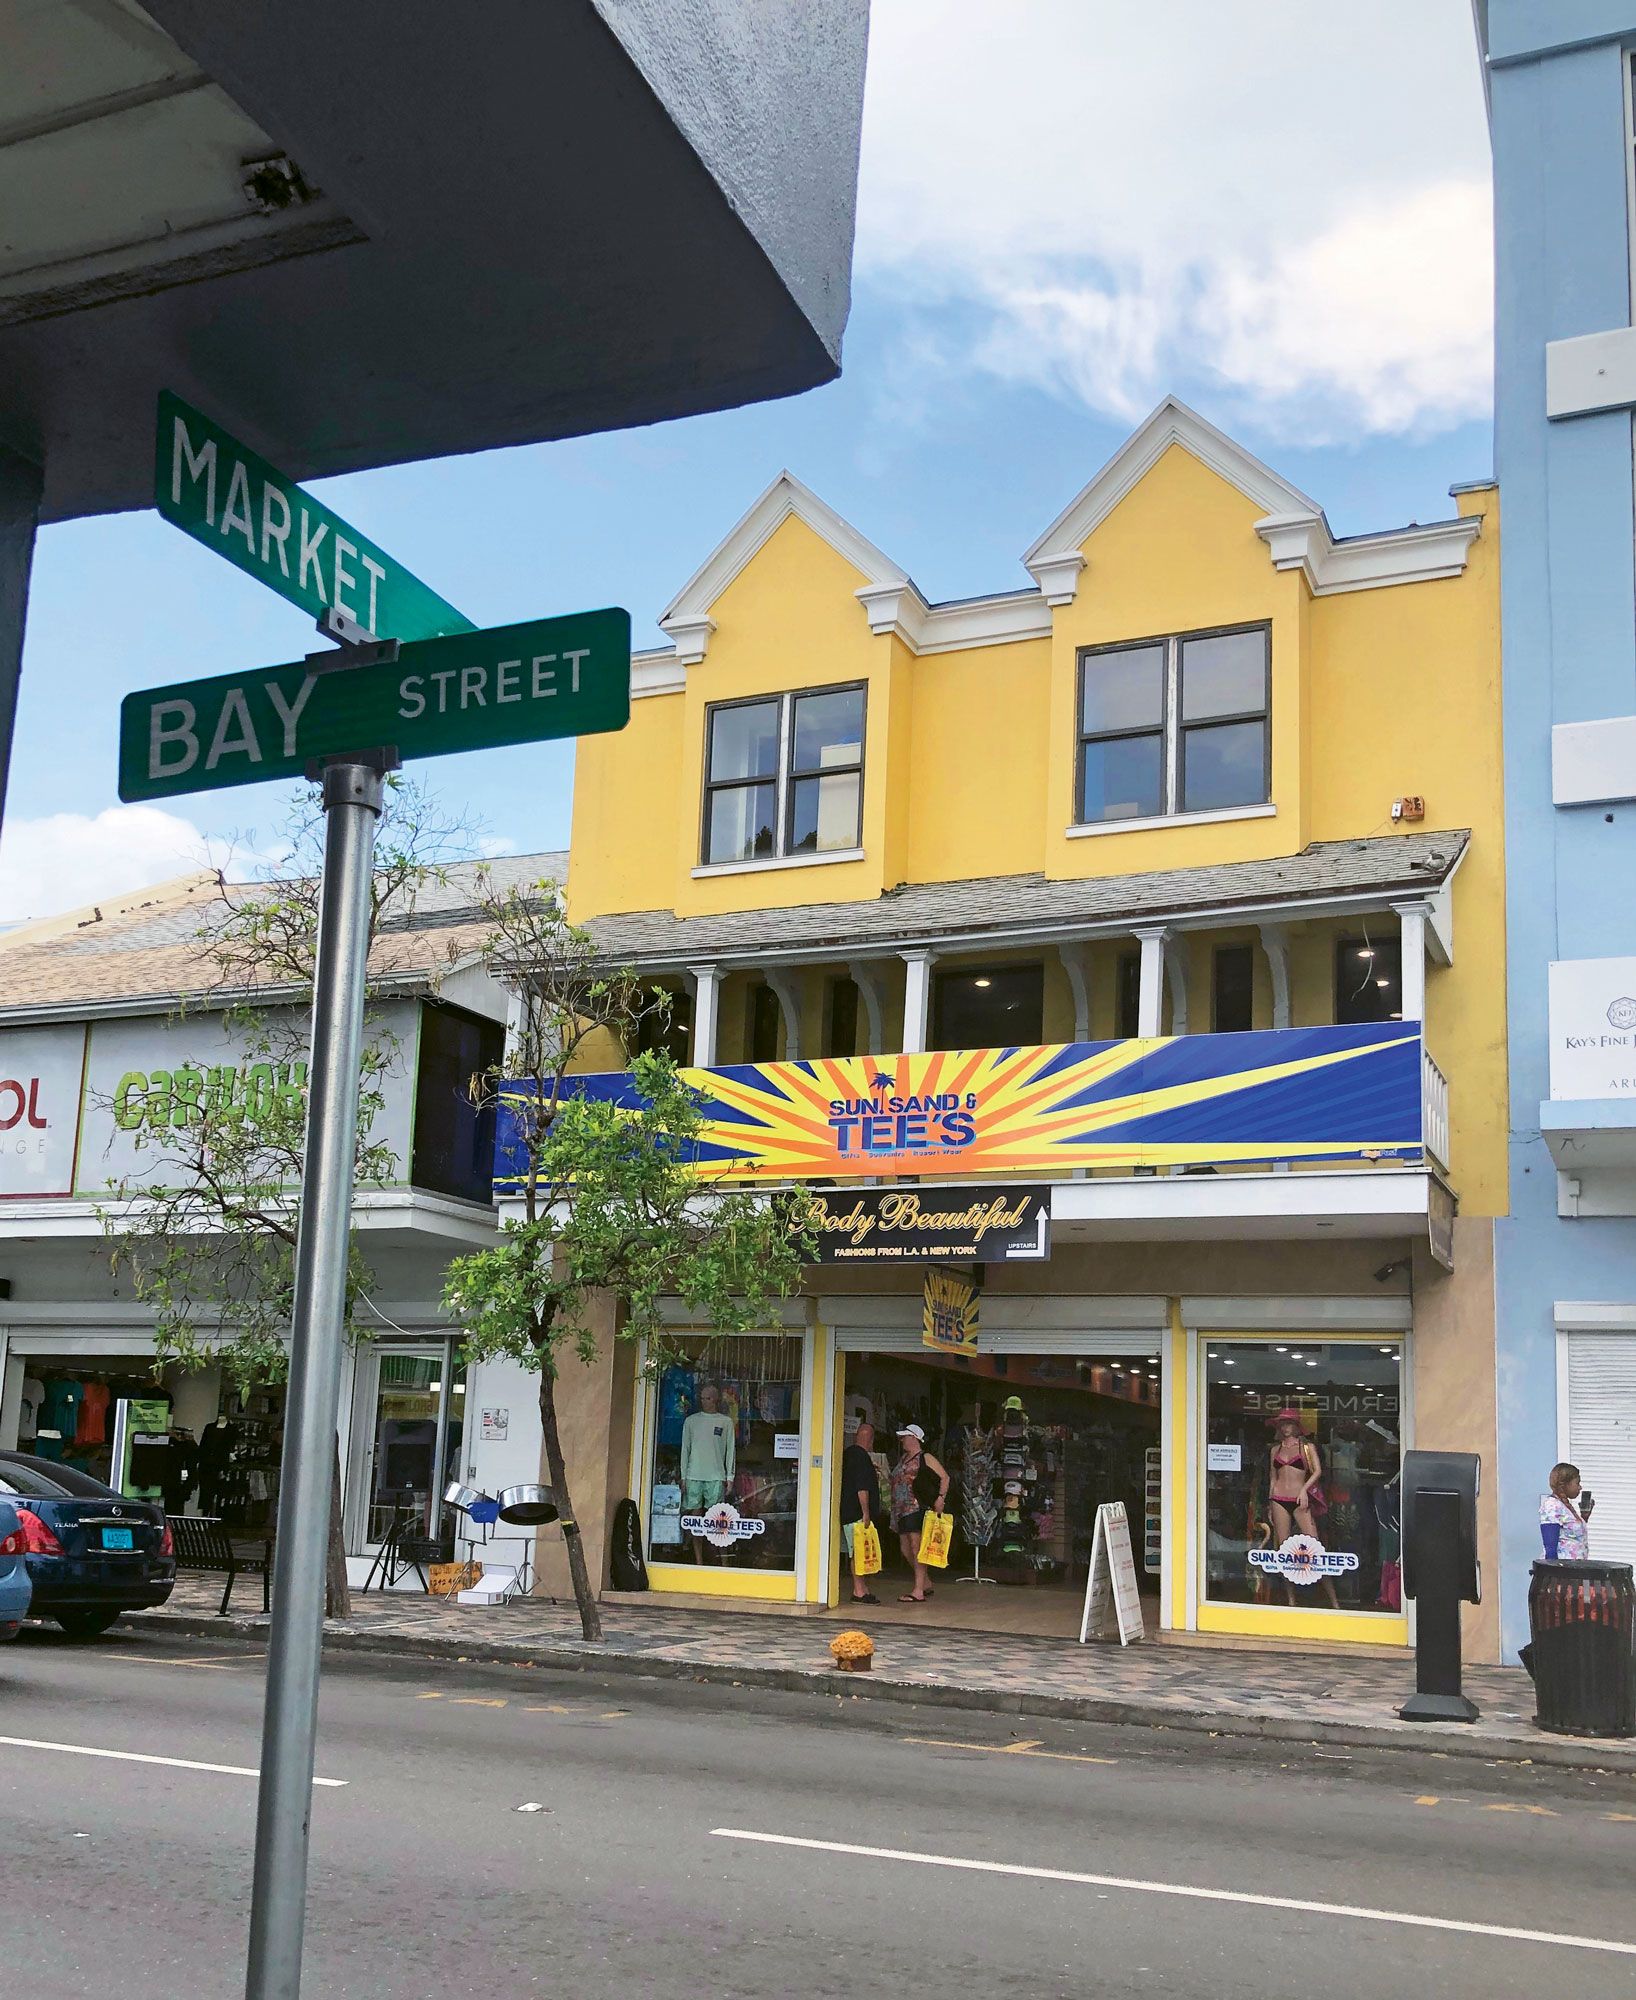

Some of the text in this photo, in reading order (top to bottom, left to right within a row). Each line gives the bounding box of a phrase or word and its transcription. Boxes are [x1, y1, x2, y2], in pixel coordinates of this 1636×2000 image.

[172, 416, 386, 640] MARKET
[148, 648, 591, 779] BAY STREET
[888, 1094, 959, 1114] SAND
[966, 1092, 977, 1109] &
[828, 1112, 977, 1151] TEE'S
[789, 1193, 1033, 1245] Body Beautiful
[834, 1246, 977, 1257] FASHIONS FROM L.A. & NEW YORK
[704, 1519, 728, 1529] SAND
[736, 1520, 762, 1532] TEE'S
[1278, 1553, 1310, 1564] SAND
[1320, 1555, 1356, 1567] TEE'S
